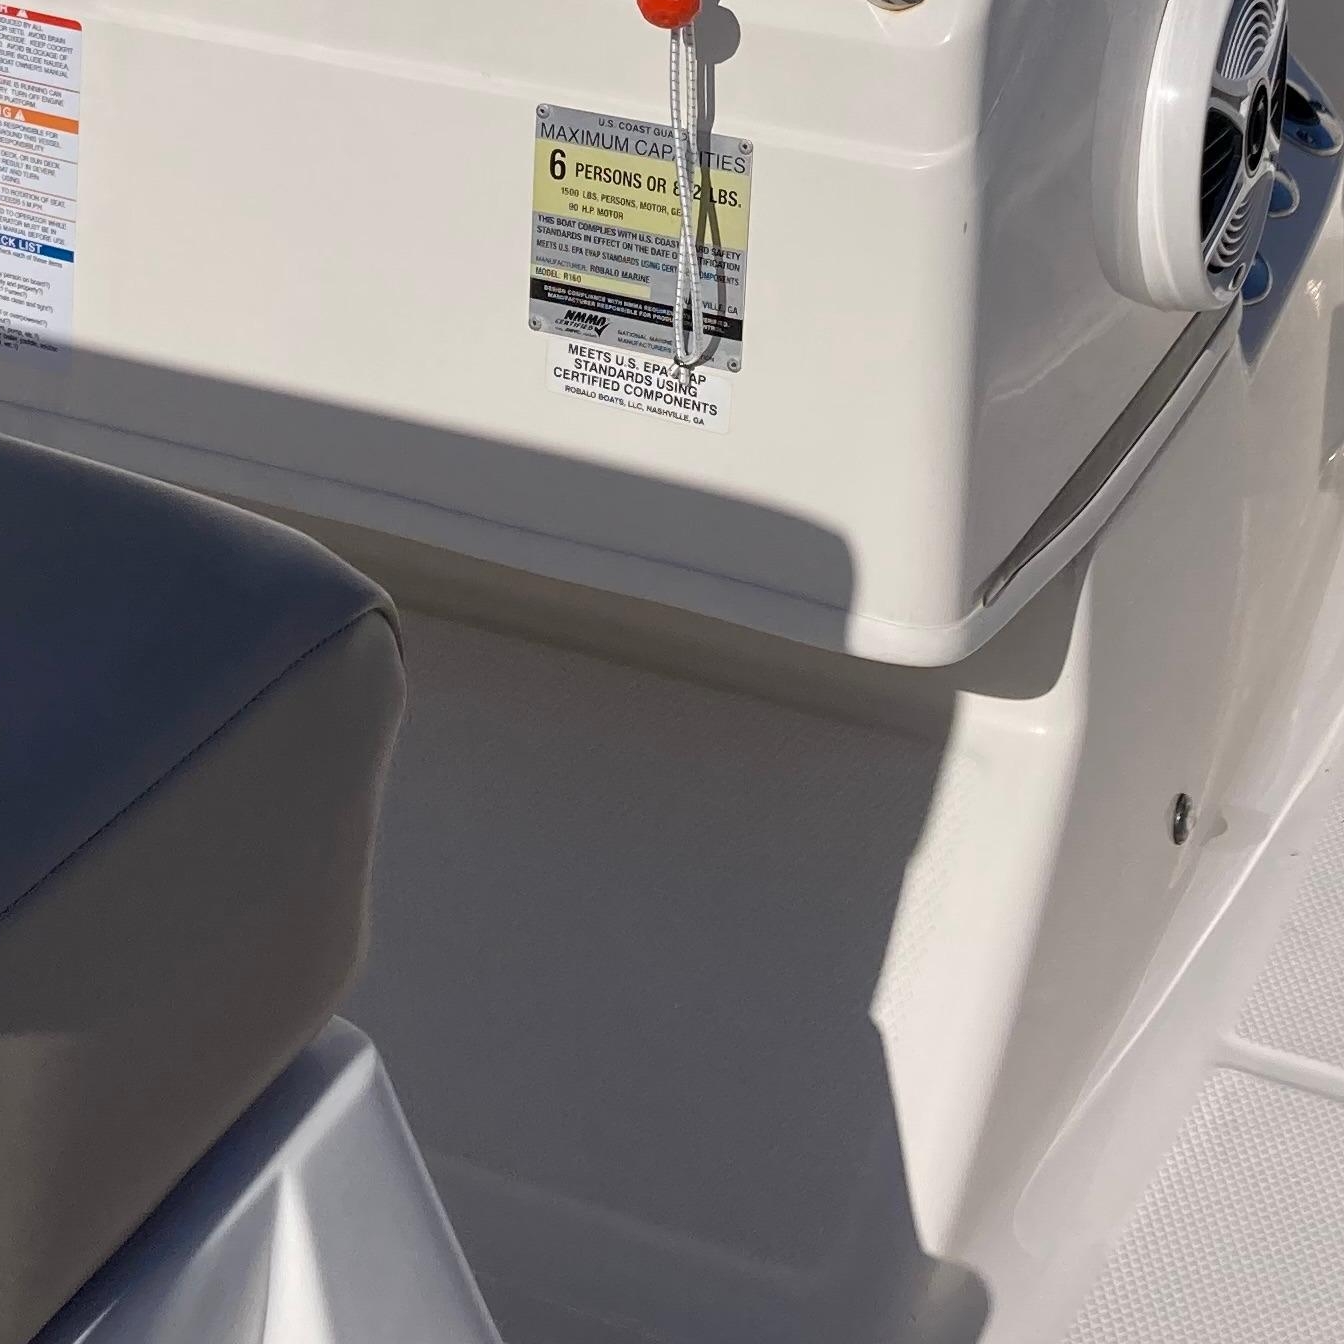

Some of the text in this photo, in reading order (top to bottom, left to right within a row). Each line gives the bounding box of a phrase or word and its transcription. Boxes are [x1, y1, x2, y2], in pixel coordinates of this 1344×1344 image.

[540, 121, 629, 152] MAXIMUM
[618, 121, 651, 134] COAST
[549, 147, 566, 181] 6
[574, 161, 642, 189] PERSONS
[646, 174, 666, 194] OR
[708, 186, 742, 208] LBS.
[560, 185, 580, 198] 1500
[596, 207, 624, 220] MOTOR
[18, 238, 42, 254] LIST
[536, 224, 582, 241] STANDARDS
[583, 233, 592, 243] IN
[593, 235, 620, 248] EFFECT
[621, 240, 633, 251] ON
[633, 243, 649, 255] THE
[650, 246, 670, 259] DATE
[555, 217, 576, 229] BOAT
[577, 221, 616, 237] COMPLIES
[616, 228, 637, 241] WITH
[654, 236, 680, 249] COAST
[710, 247, 741, 261] SAFETY
[620, 270, 651, 284] MARINE
[567, 342, 612, 363] MEETS
[614, 354, 639, 370] U.S.
[643, 361, 668, 377] EPA
[553, 366, 718, 416] CERTIFIED COMPONENTS
[573, 357, 697, 398] STANDARDS USING
